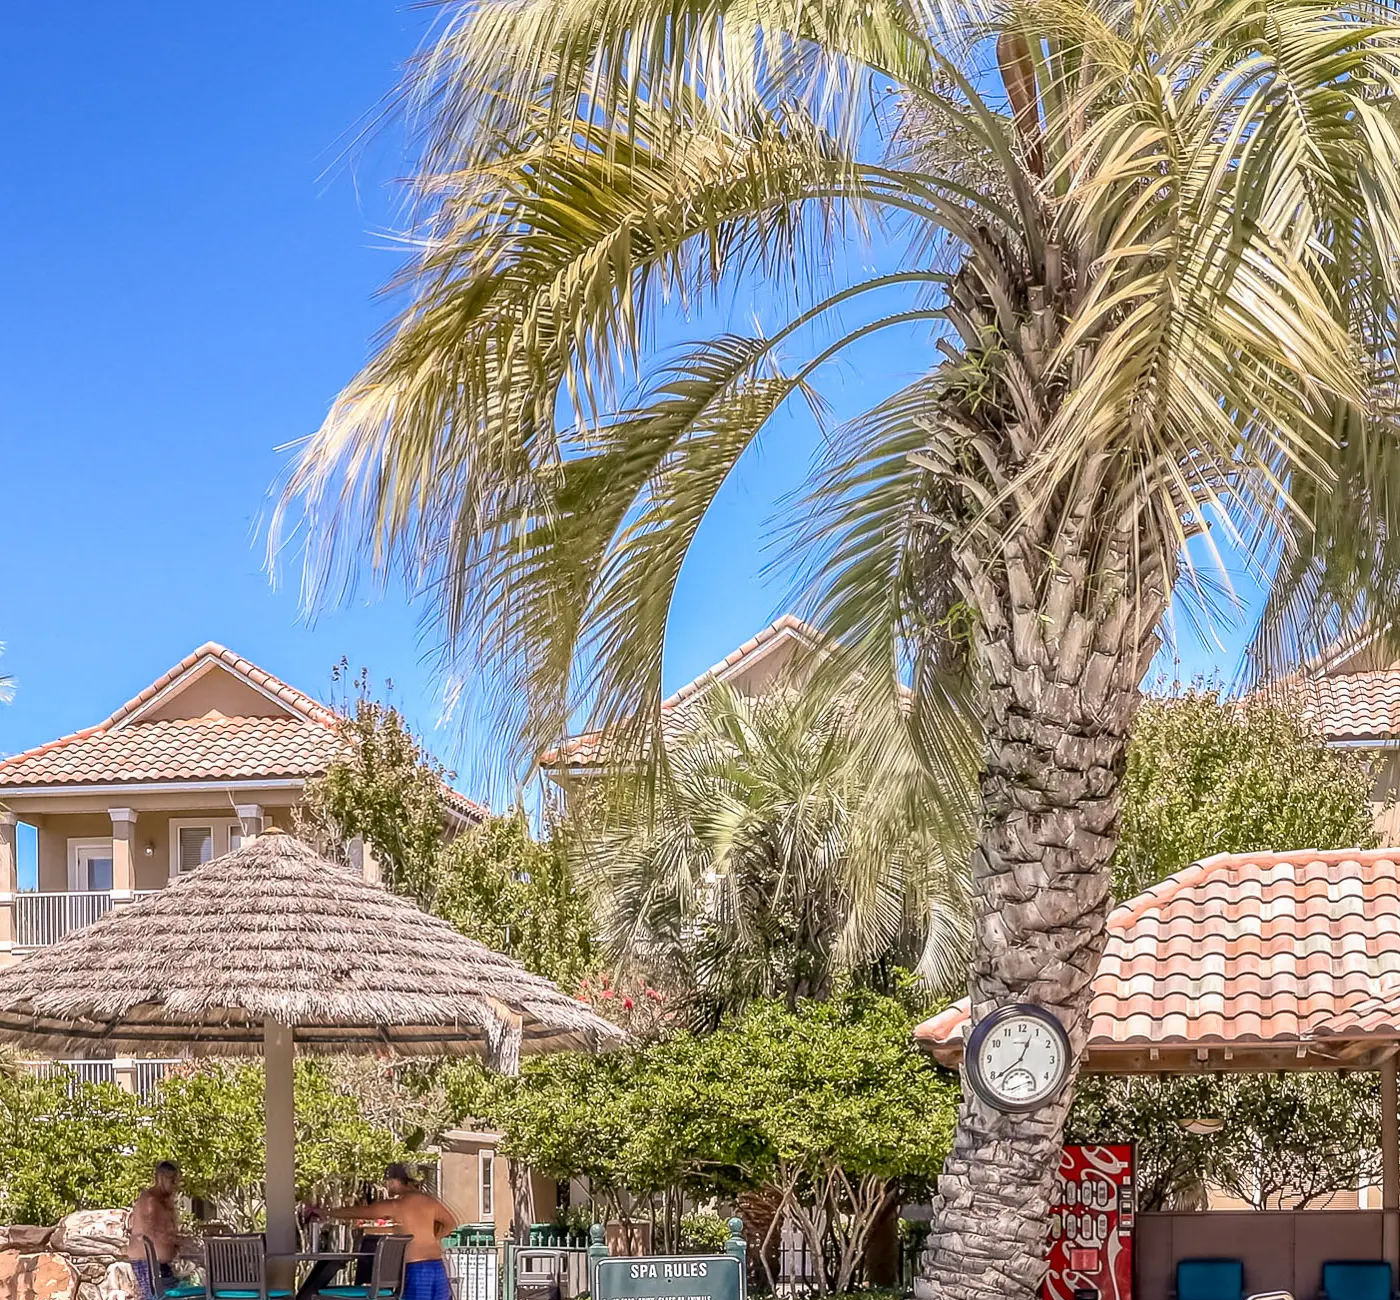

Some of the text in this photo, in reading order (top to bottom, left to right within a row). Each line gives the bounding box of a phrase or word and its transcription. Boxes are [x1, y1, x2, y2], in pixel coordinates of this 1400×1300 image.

[1004, 1028, 1011, 1037] 11
[1018, 1024, 1027, 1033] 12
[992, 1039, 1001, 1048] 10
[1045, 1040, 1051, 1048] 2
[987, 1054, 992, 1063] 9
[1049, 1055, 1055, 1064] 3
[990, 1071, 996, 1079] 8
[1044, 1072, 1049, 1080] 4
[630, 1262, 708, 1278] SPA RULES
